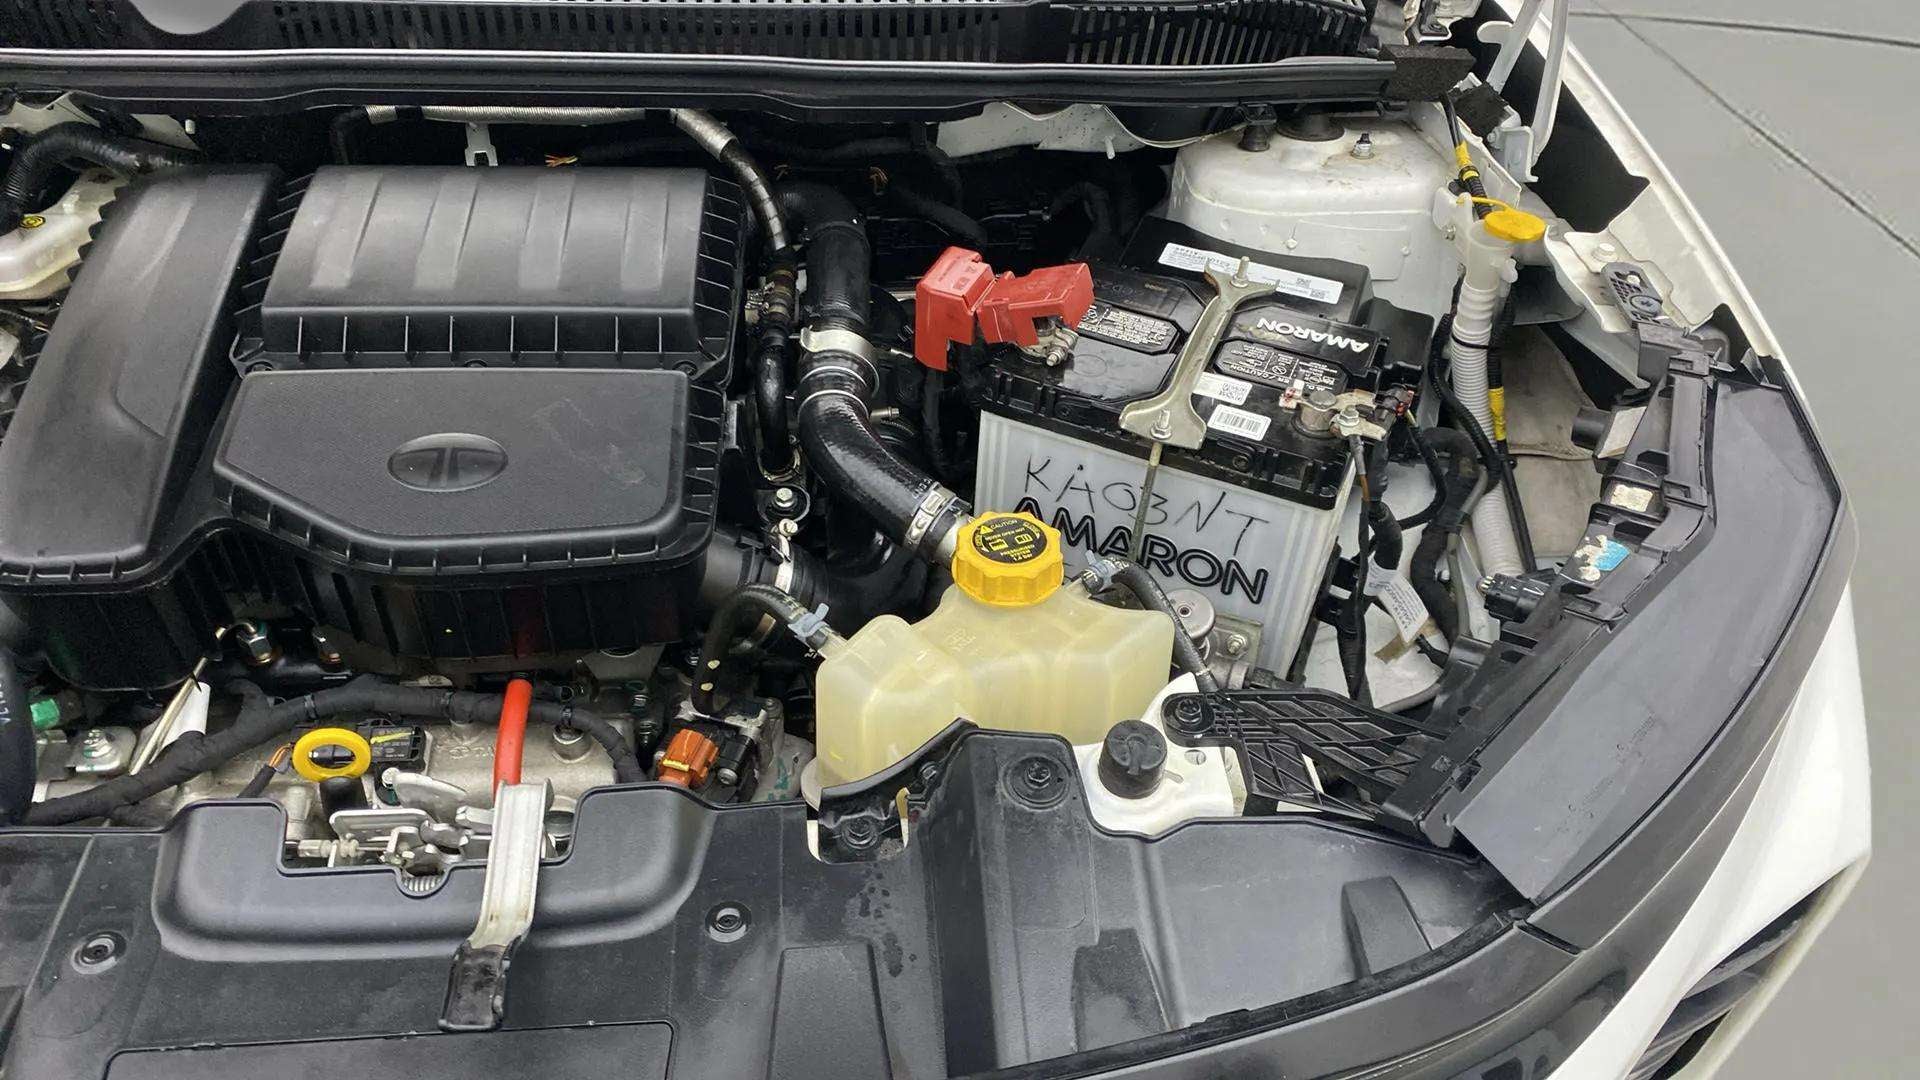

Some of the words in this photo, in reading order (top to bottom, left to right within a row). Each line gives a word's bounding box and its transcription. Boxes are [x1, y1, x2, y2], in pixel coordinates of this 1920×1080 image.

[1256, 317, 1370, 353] AMARON
[1229, 363, 1269, 379] CAUTION
[990, 519, 1018, 530] CAUTION
[1013, 496, 1269, 605] AMARON
